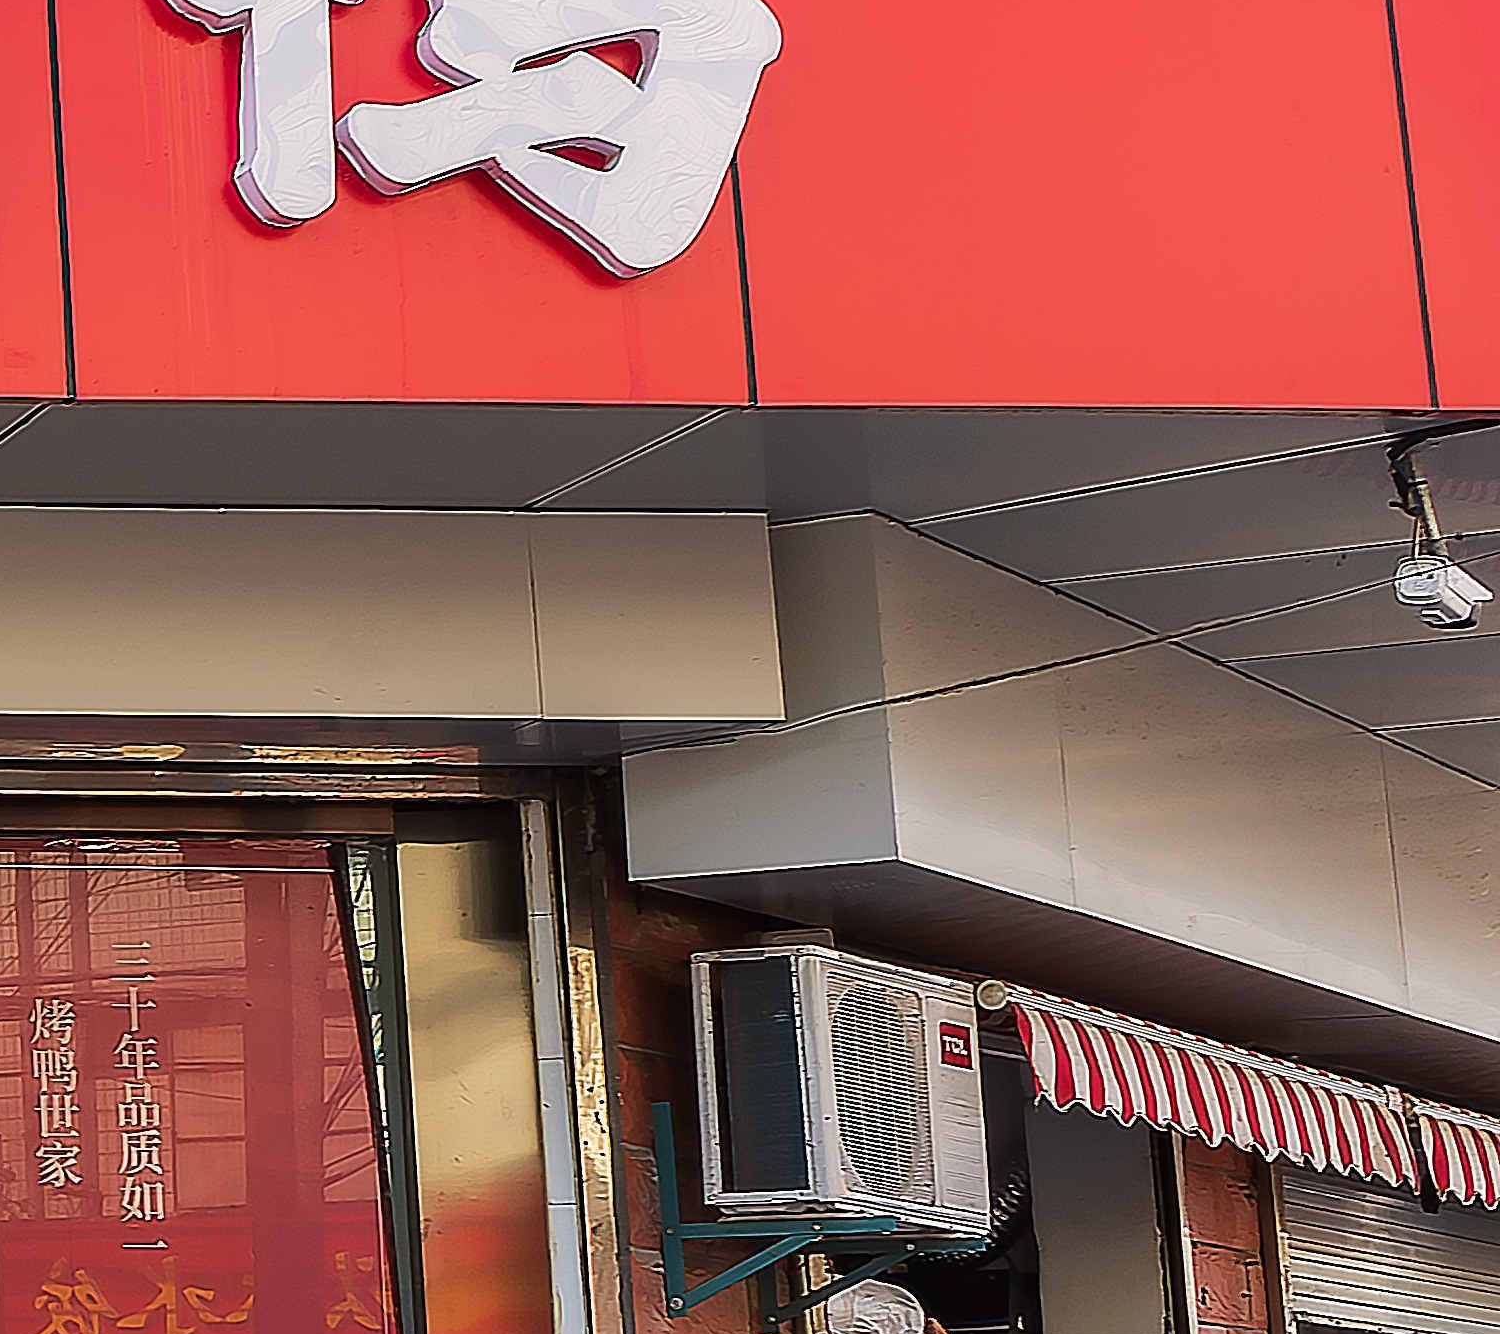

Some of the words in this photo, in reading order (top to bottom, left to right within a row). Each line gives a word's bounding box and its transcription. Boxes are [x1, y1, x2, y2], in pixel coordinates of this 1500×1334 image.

[30, 998, 83, 1189] 烤鸭世家
[107, 940, 169, 1253] 三十年品质如一
[942, 1035, 969, 1057] TCL
